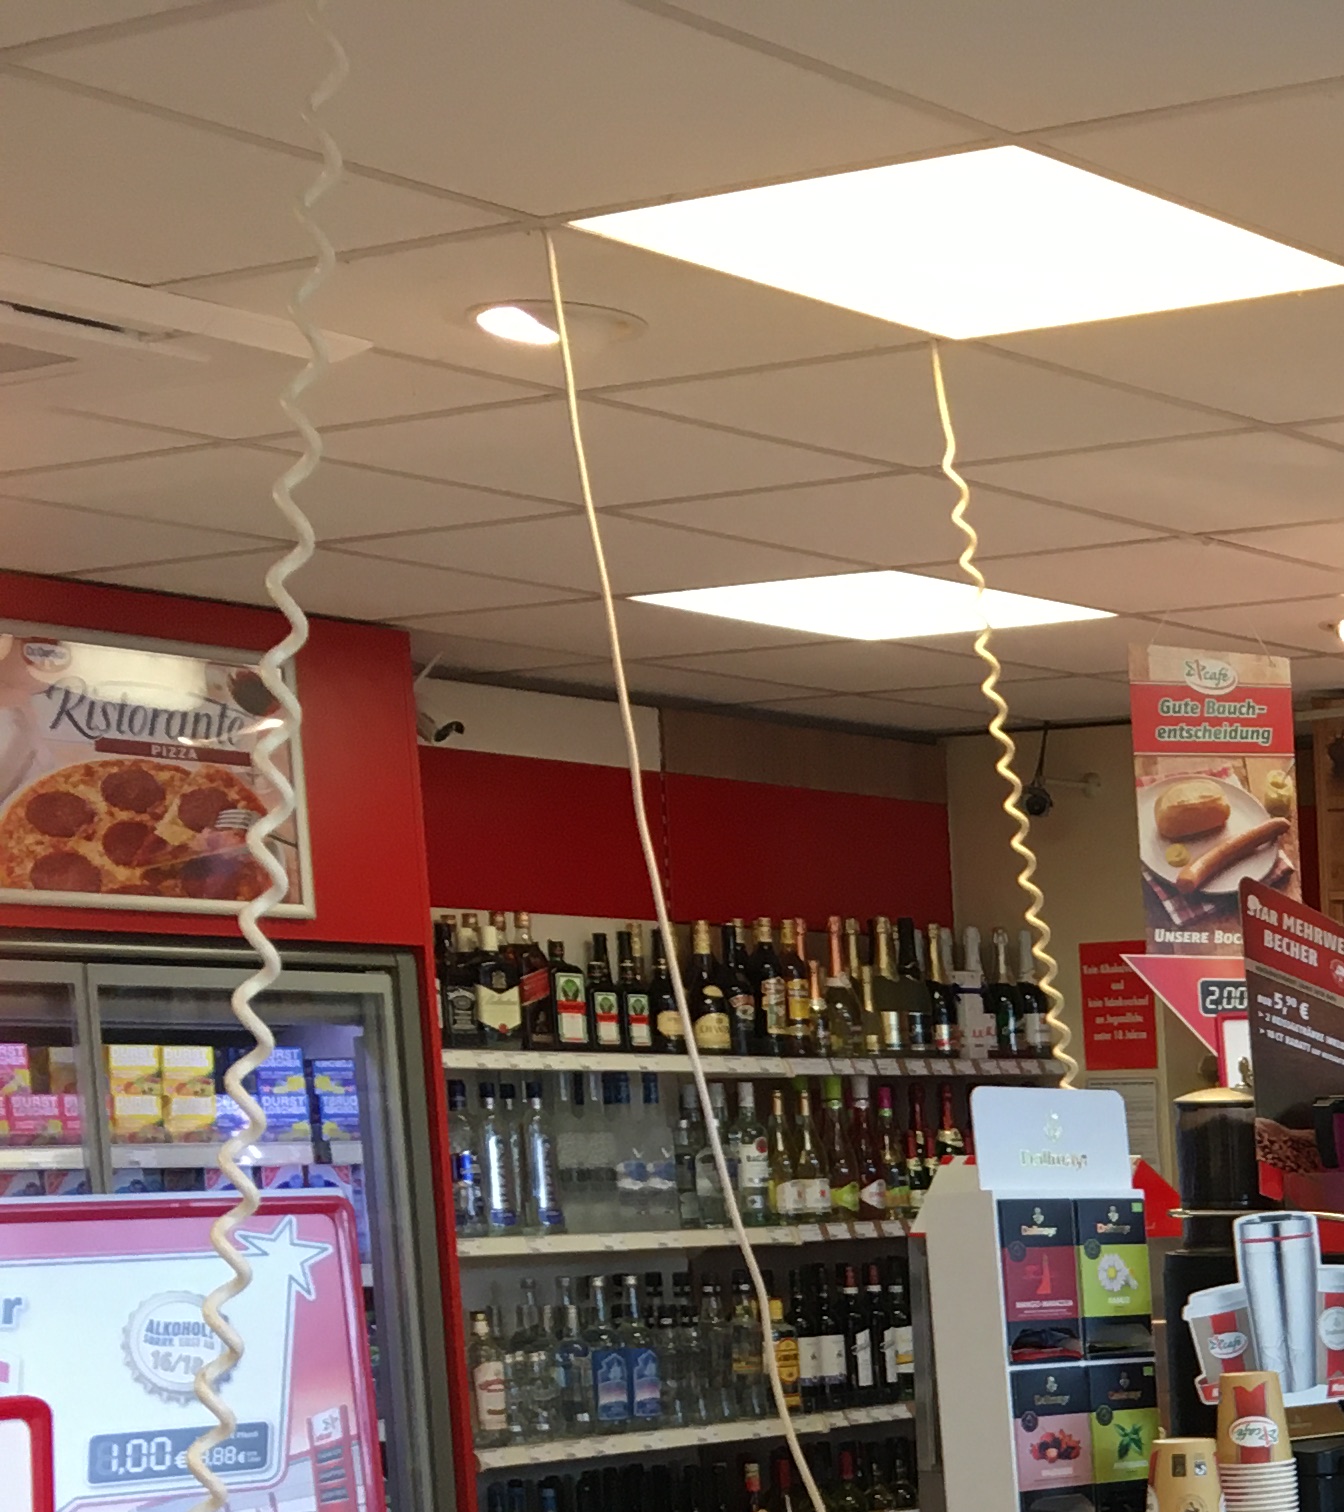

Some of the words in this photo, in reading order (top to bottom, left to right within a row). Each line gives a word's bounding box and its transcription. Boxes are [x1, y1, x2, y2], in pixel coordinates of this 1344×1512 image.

[44, 678, 246, 745] Ristorante
[1159, 699, 1201, 716] Gute
[1205, 700, 1266, 717] Bauch-
[1156, 724, 1272, 747] entscheidung
[151, 744, 199, 760] PIZZA
[1154, 929, 1209, 943] UNSERE
[1263, 929, 1318, 967] BECHER
